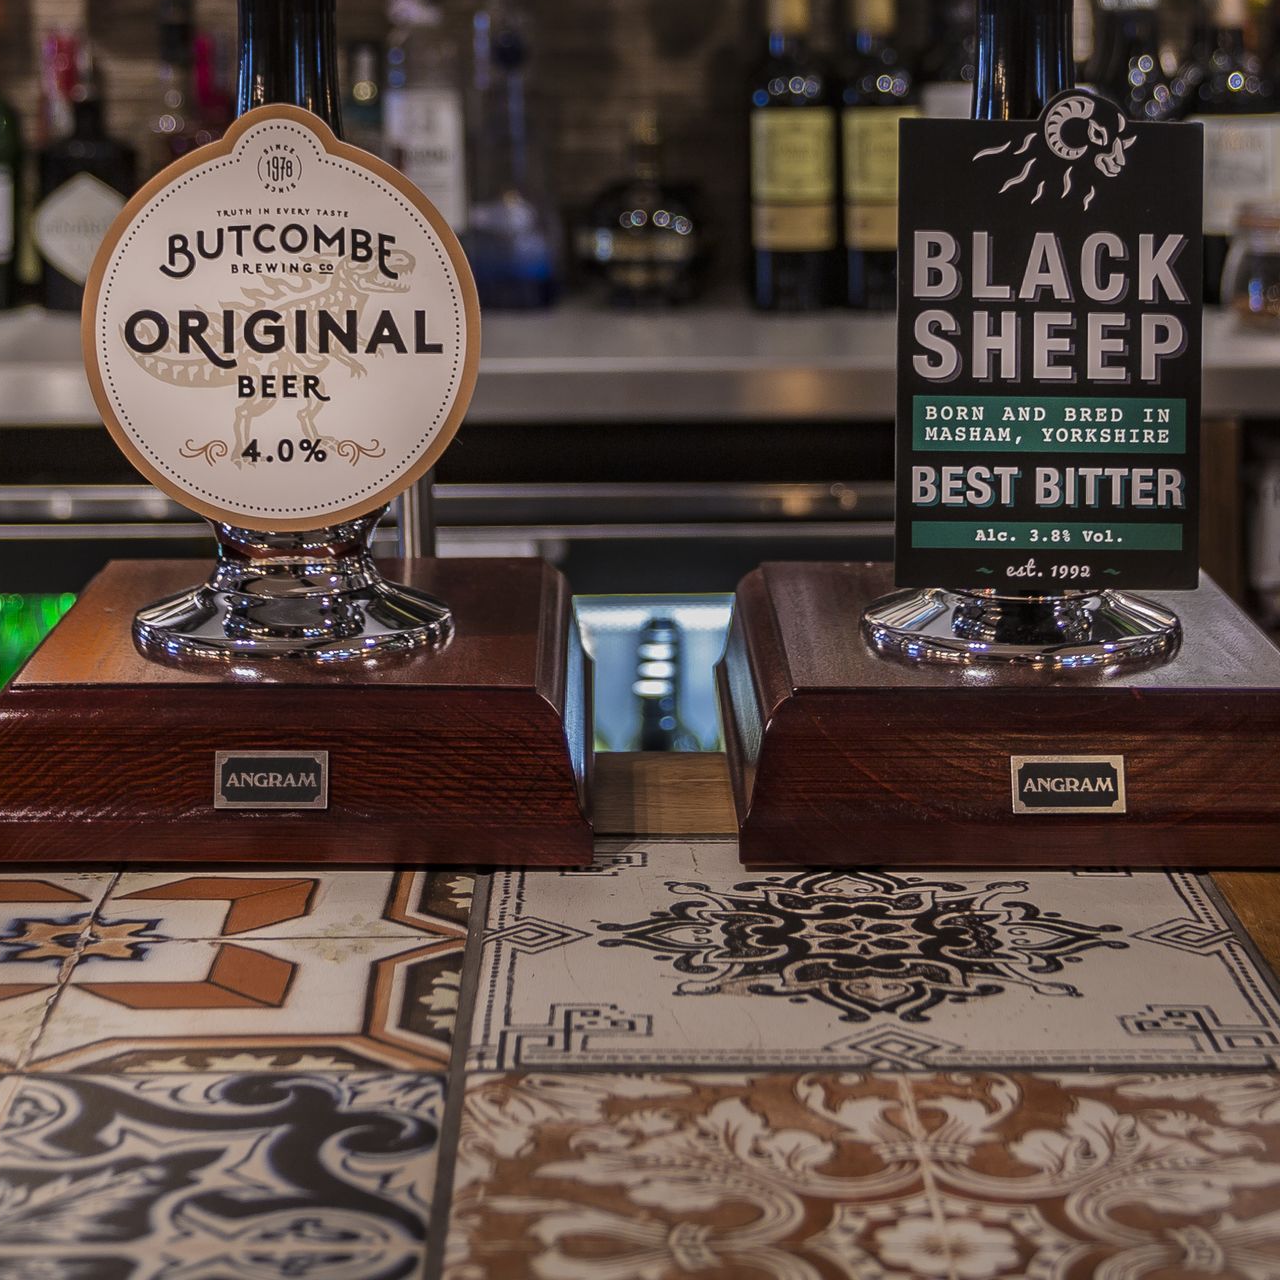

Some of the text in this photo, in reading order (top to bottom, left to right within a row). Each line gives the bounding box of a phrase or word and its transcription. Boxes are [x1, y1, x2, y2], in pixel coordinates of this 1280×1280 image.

[263, 144, 296, 155] SINCE
[266, 156, 293, 182] 1978
[216, 207, 350, 218] TRUTH IN EVERY TASTE
[159, 223, 399, 280] BUTCOMBE
[231, 263, 313, 275] BREWING
[913, 230, 1191, 305] BLACK
[124, 309, 444, 370] ORIGINAL
[912, 309, 1189, 385] SHEEP
[237, 374, 331, 402] BEER
[925, 405, 1170, 423] BORN AND BRED IN
[924, 426, 1170, 445] MASHAM, YORKSHIRE
[241, 438, 327, 463] 4.0%
[912, 465, 1186, 509] BEST BITTER
[975, 529, 1123, 543] Alc. 3.8% Vol.
[1006, 557, 1091, 578] est. 1992
[225, 772, 317, 787] ANGRAM
[1023, 777, 1114, 792] ANGRAM
